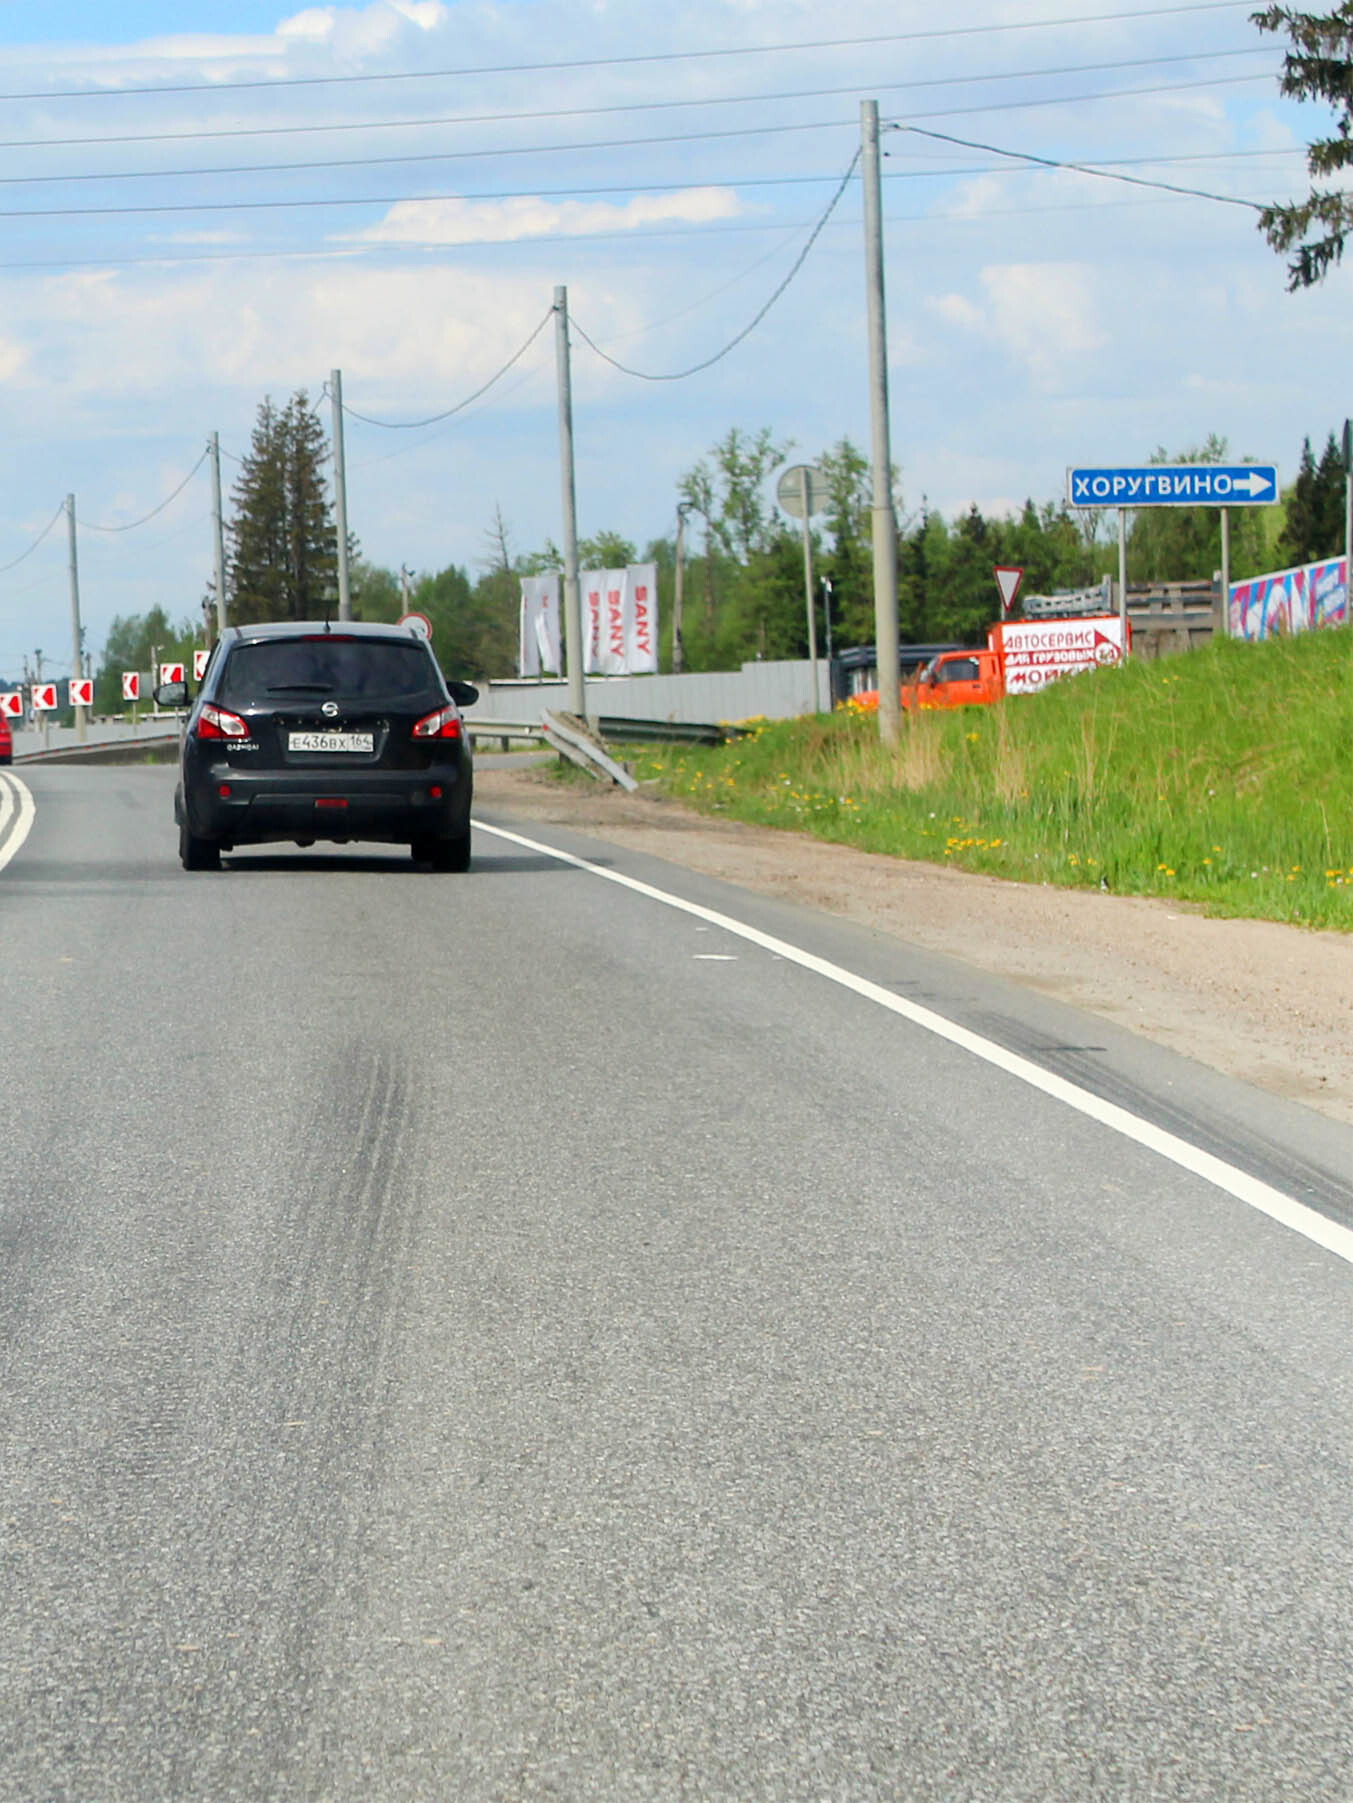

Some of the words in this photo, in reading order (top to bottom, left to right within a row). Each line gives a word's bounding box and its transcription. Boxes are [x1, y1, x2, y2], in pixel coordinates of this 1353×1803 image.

[1075, 474, 1233, 497] ХОРУГВИНО
[608, 589, 624, 657] SANY
[635, 585, 652, 656] SANY
[1005, 630, 1092, 649] АВТОСЕРВИС
